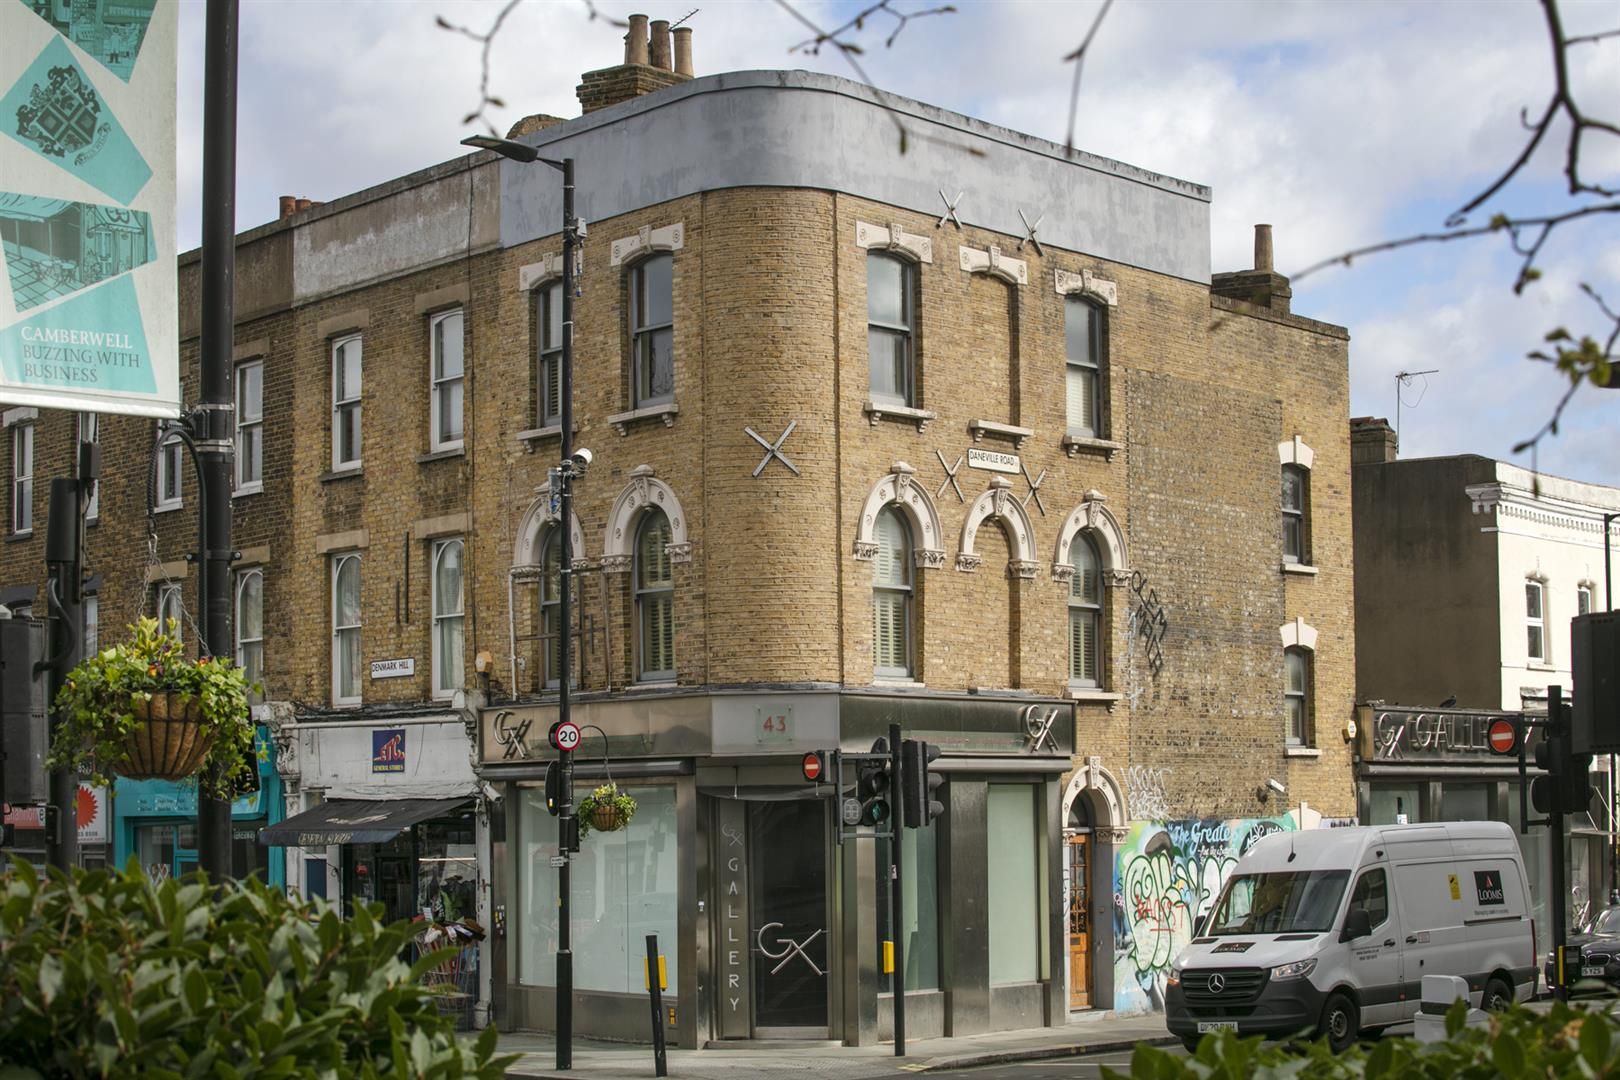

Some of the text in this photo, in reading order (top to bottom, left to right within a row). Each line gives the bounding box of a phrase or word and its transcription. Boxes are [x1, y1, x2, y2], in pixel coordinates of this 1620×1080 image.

[21, 326, 133, 349] CAMBERWELL
[23, 345, 140, 368] BUZZING WITH
[24, 363, 98, 382] BUSINESS
[1000, 455, 1015, 466] ROAD
[372, 660, 409, 672] DENMARK HILL
[763, 715, 786, 732] 43
[560, 731, 577, 742] 20
[1479, 889, 1503, 900] LOOMIS
[728, 857, 740, 1011] GALLERY
